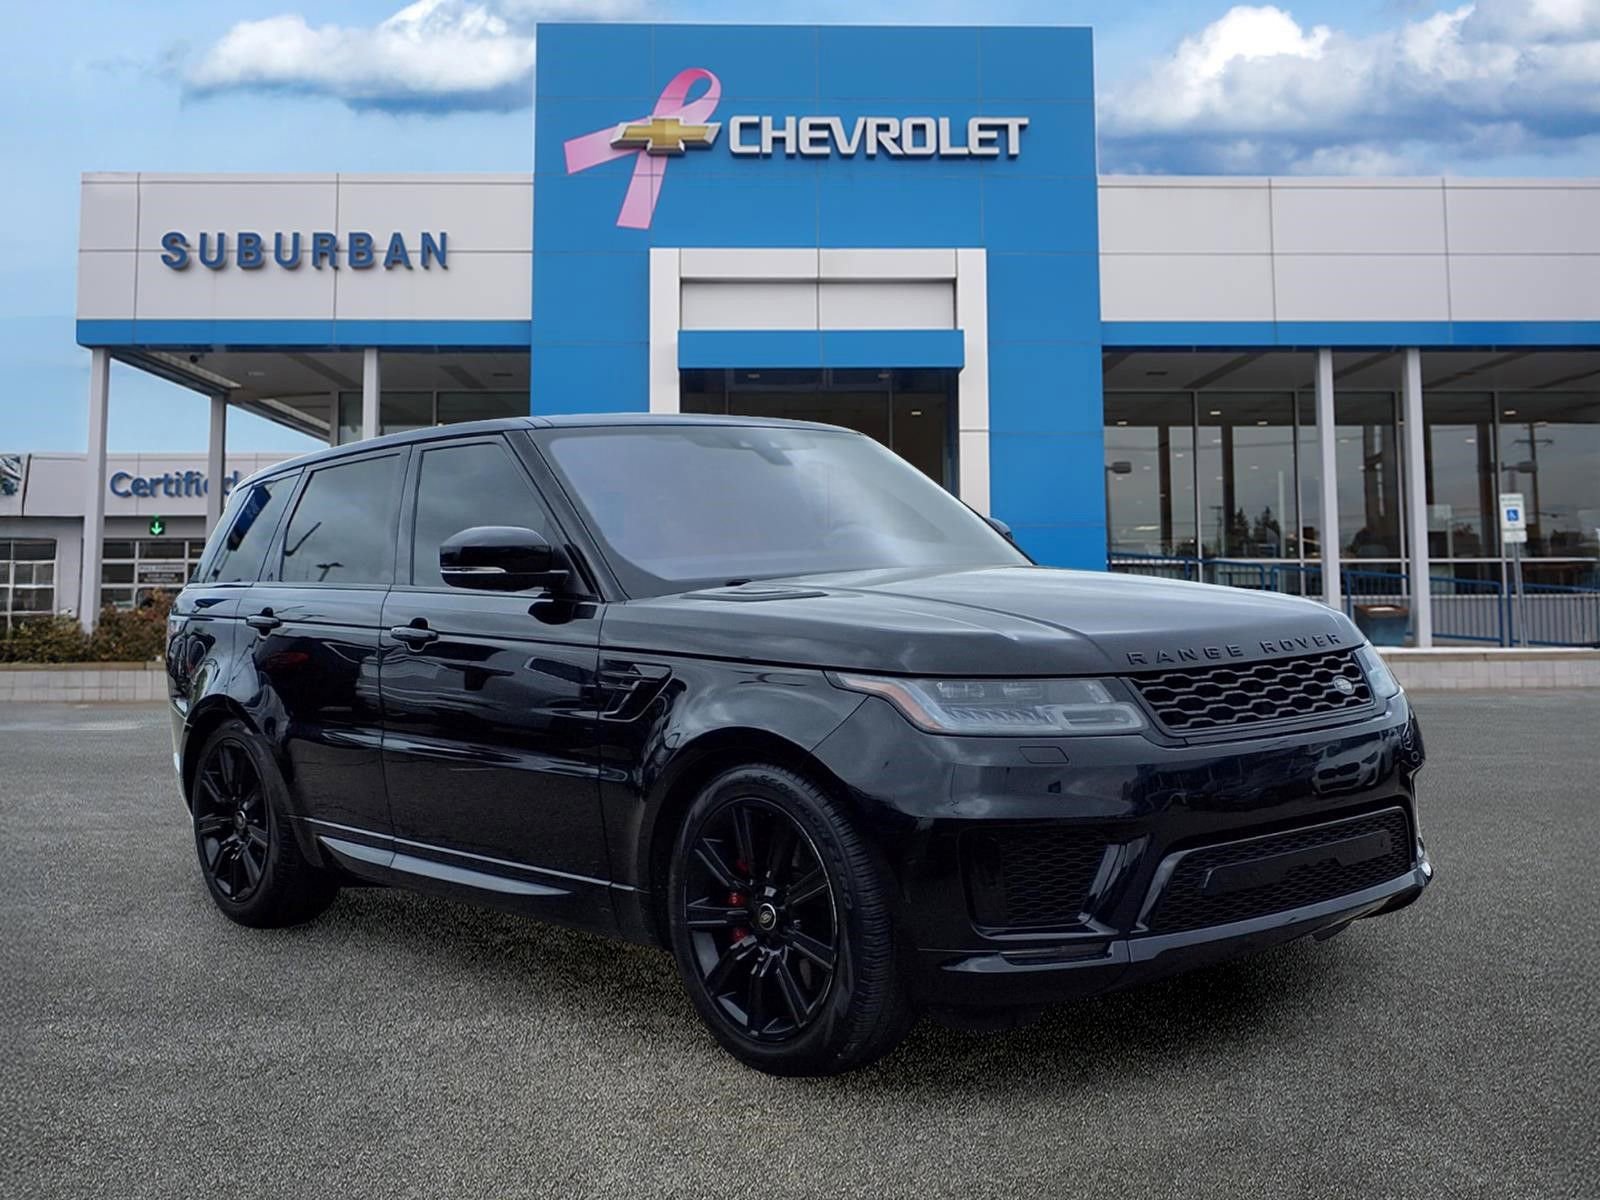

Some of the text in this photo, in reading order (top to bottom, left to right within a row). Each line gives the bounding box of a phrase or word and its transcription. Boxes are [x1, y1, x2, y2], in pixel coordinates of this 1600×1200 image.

[728, 115, 1029, 157] CHEVROLET
[161, 231, 449, 271] SUBURBAN
[110, 470, 239, 498] Certifid
[1126, 632, 1343, 667] RANGE ROVER
